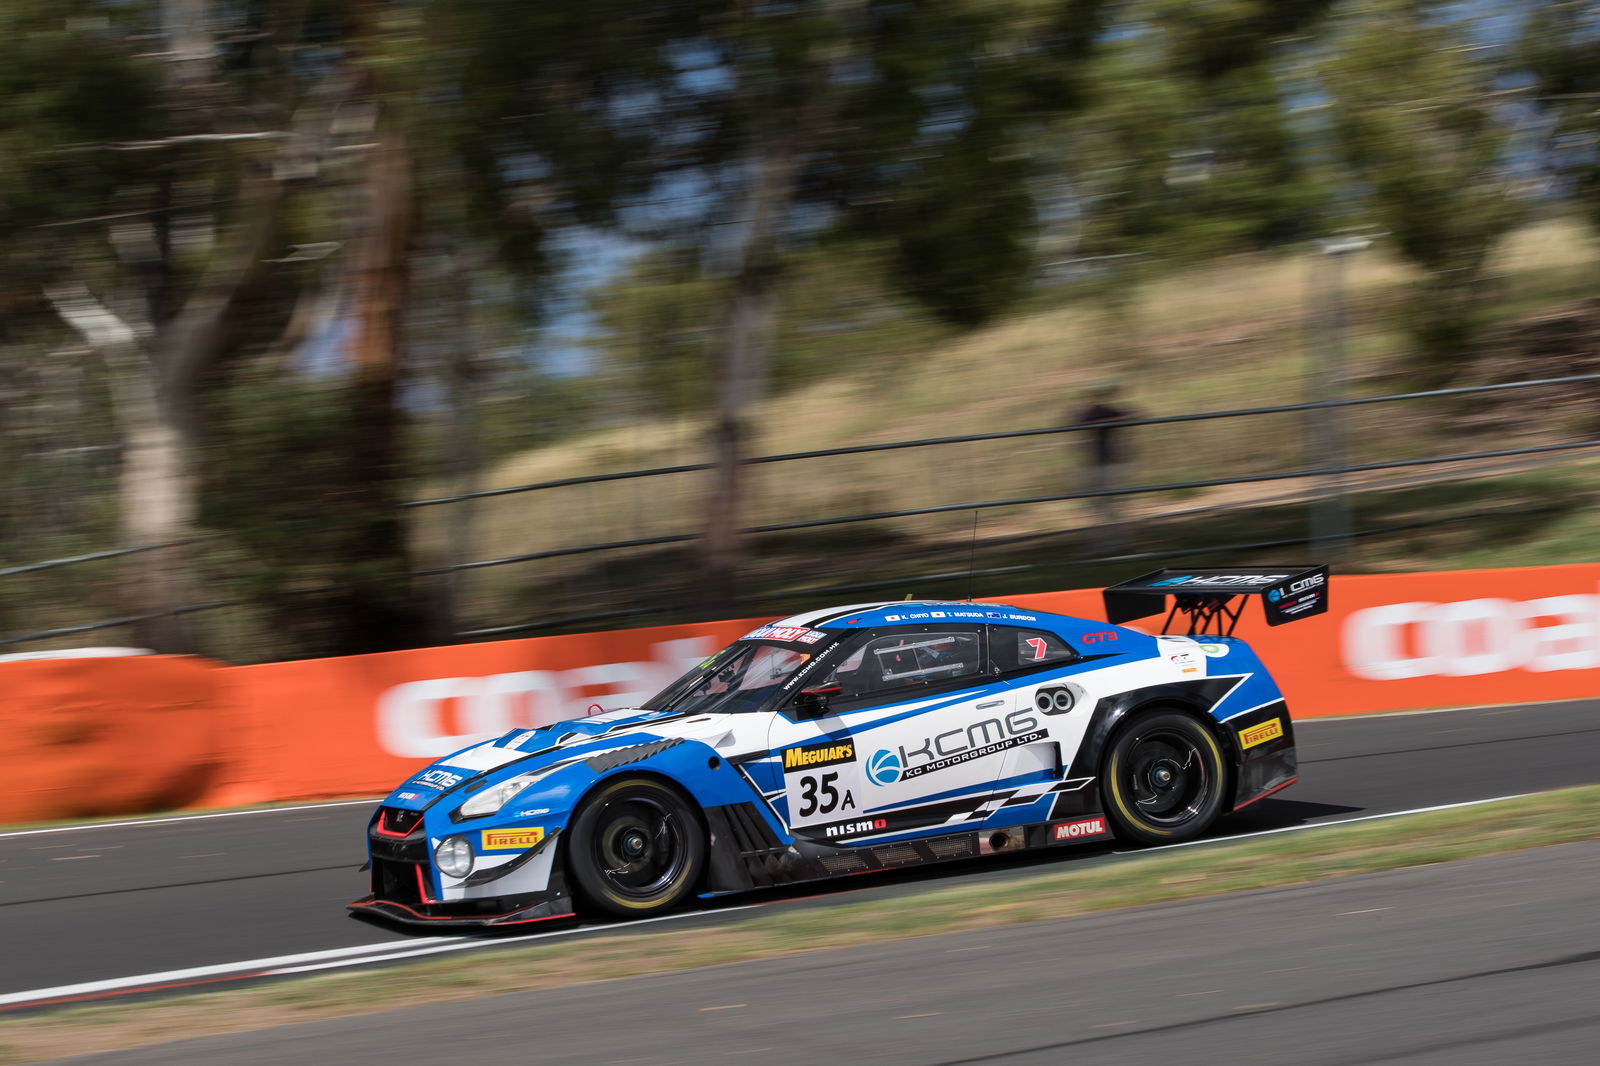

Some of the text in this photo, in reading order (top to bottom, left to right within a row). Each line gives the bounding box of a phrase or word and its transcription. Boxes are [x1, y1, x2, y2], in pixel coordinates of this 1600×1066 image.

[762, 627, 806, 641] MOLY
[1081, 630, 1118, 644] GT3
[1340, 586, 1600, 681] coa
[898, 707, 1038, 768] KCMG
[1243, 722, 1279, 745] PIRELLI
[785, 744, 854, 768] MEGUIAR'S
[906, 733, 1042, 778] KC MOTORGROUP LTD.
[487, 831, 538, 846] PIRELLI
[1056, 820, 1103, 839] MOTUL
